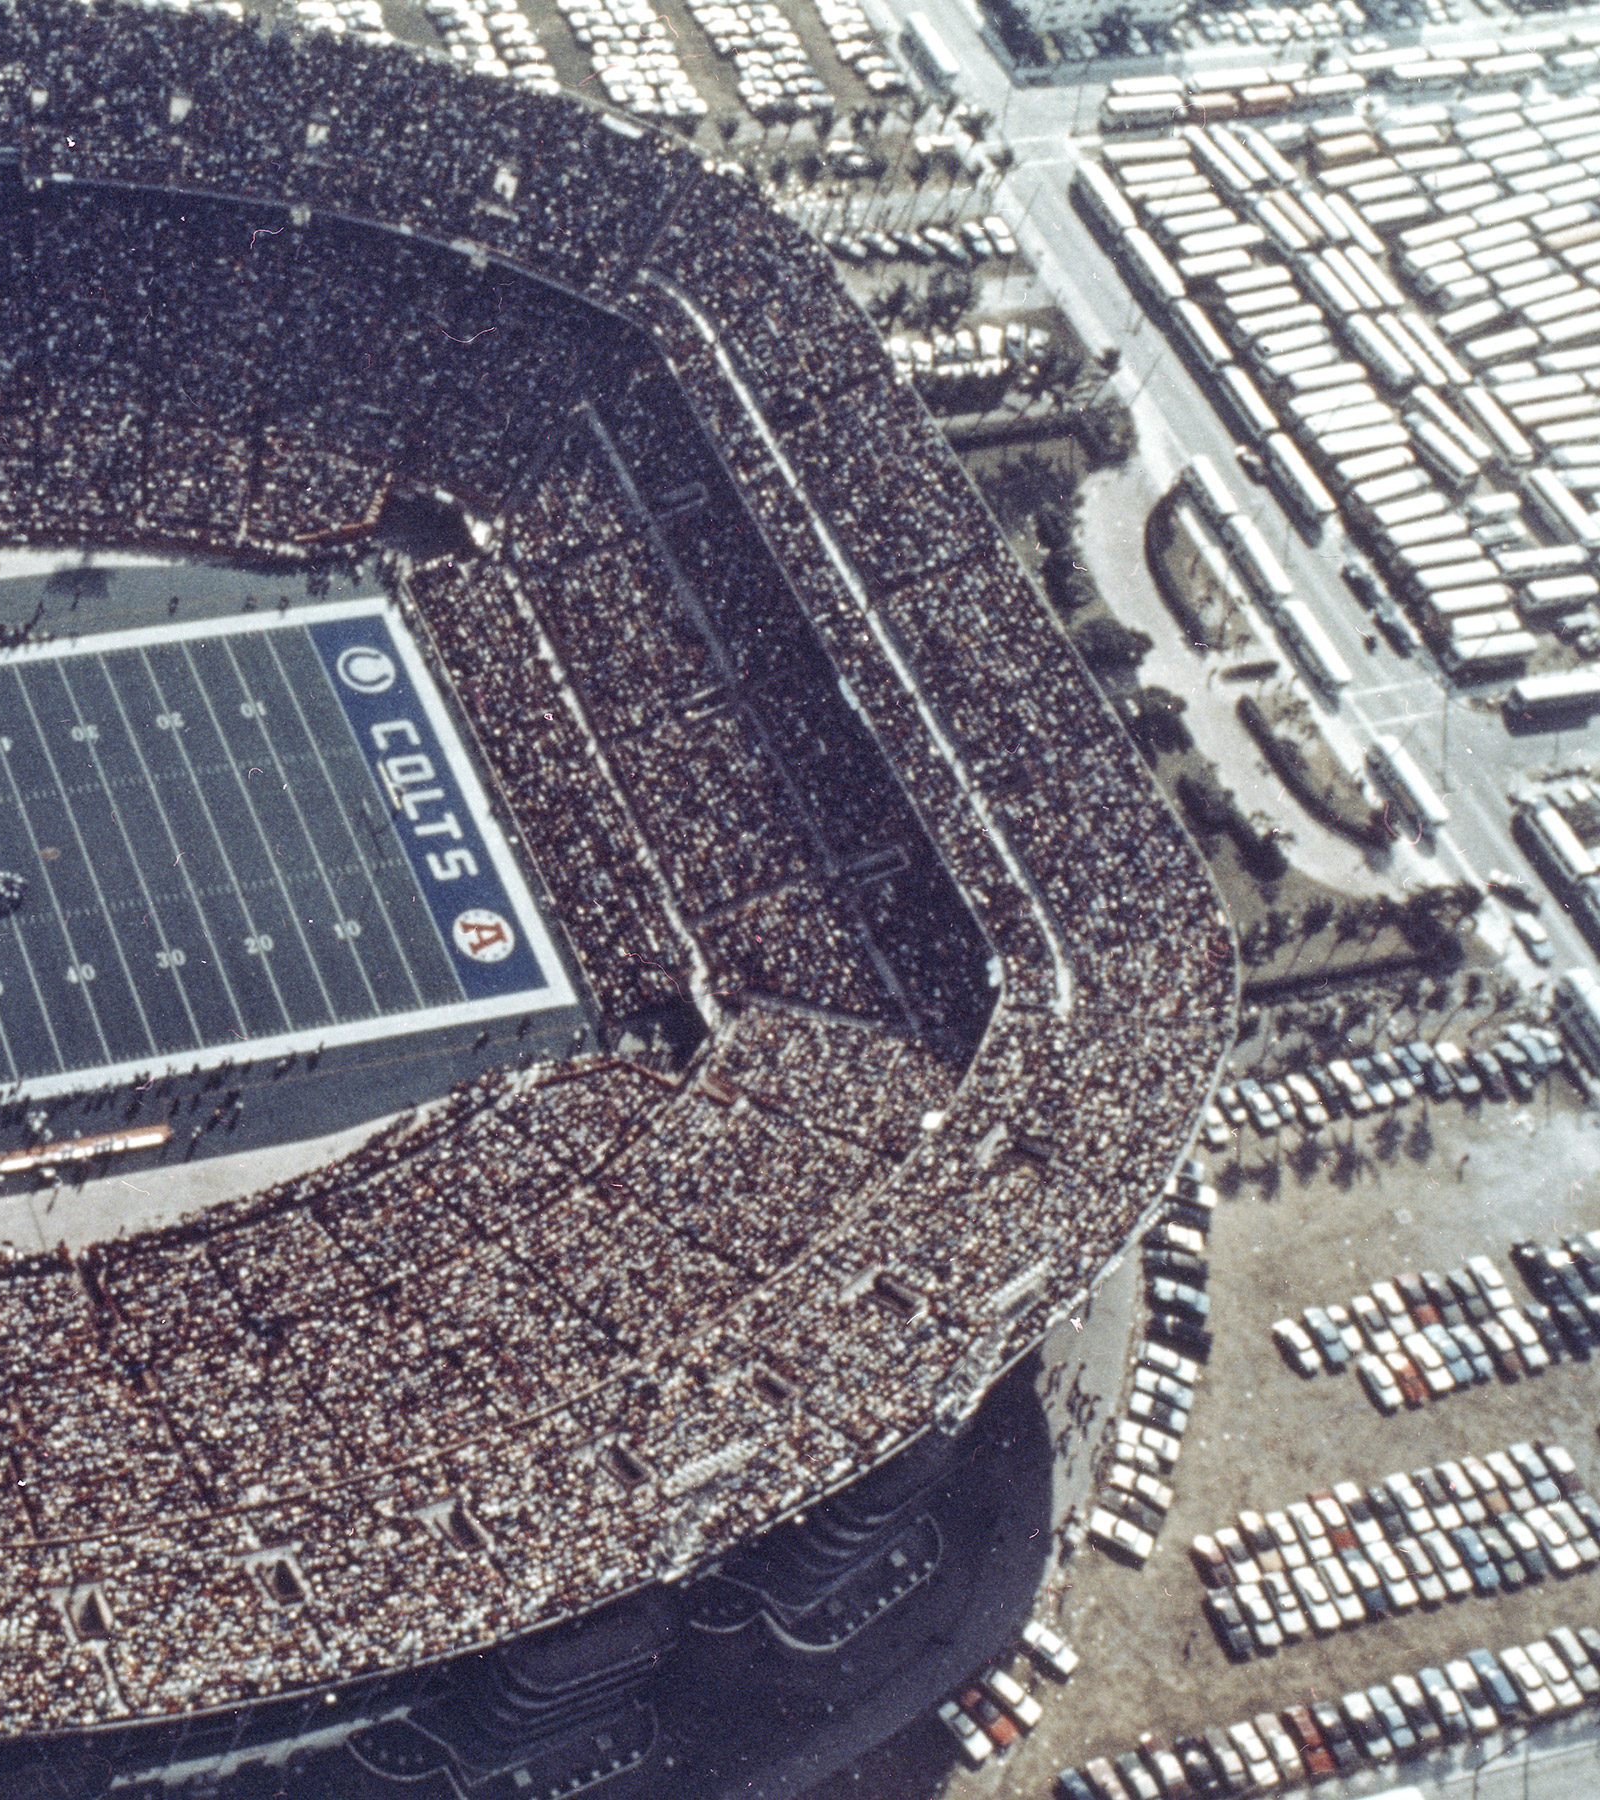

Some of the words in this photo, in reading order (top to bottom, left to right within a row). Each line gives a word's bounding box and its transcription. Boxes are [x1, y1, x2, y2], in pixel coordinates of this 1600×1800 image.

[370, 719, 479, 881] COLTS
[333, 920, 362, 940] 10
[458, 920, 509, 956] A
[244, 934, 275, 955] 20
[155, 948, 186, 969] 30
[65, 963, 96, 984] 40
